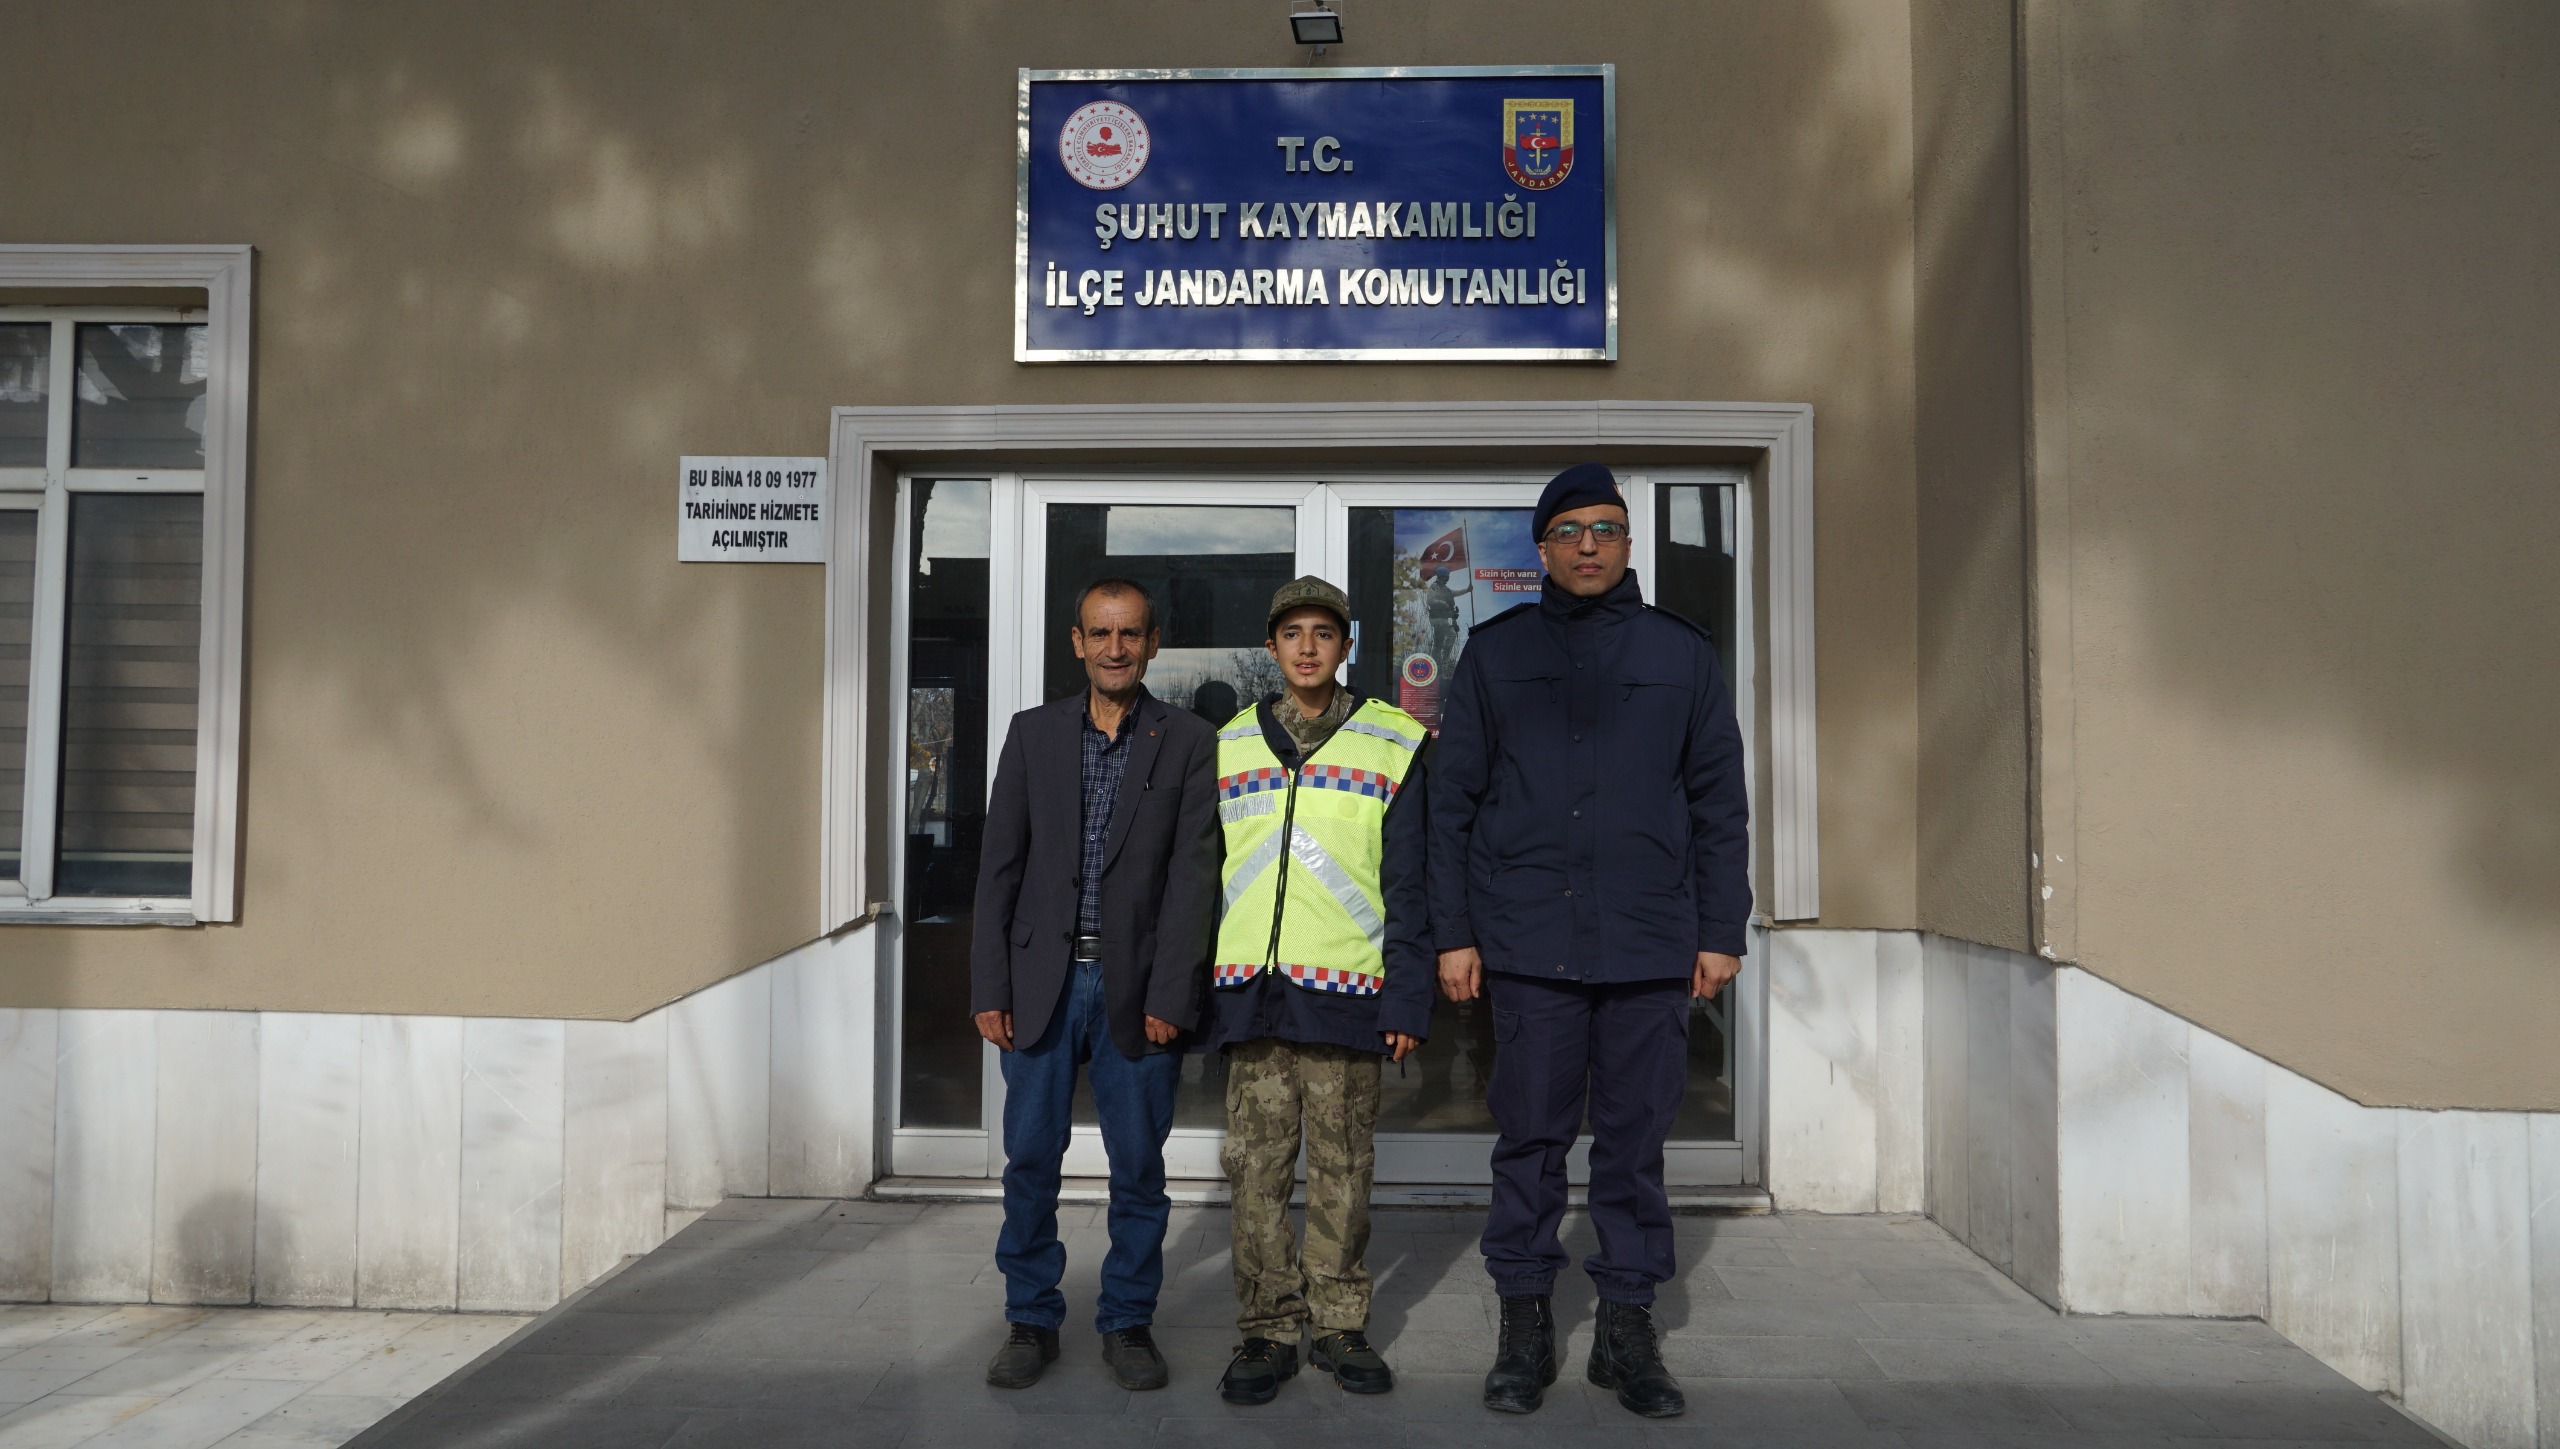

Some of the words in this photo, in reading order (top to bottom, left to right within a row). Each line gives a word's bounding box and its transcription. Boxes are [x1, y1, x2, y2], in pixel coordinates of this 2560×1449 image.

[1278, 136, 1353, 172] T.C.
[1508, 162, 1570, 187] JANDARMA
[1095, 203, 1227, 250] ŞUHUT
[1240, 193, 1536, 238] KAYMAKAMLIĞI
[1046, 261, 1124, 316] İLÇE
[1134, 268, 1329, 306] JANDARMA
[1339, 258, 1586, 306] KOMUTANLIĞI
[689, 469, 707, 487] BU
[711, 466, 743, 488] BİNA
[746, 470, 762, 488] 18
[765, 470, 782, 488] 09
[786, 471, 817, 488] 1977
[685, 499, 756, 520] TARİHİNDE
[760, 499, 819, 521] HİZMETE
[712, 530, 788, 552] AÇILMIŞTIR
[1479, 569, 1499, 578] Sizin
[1500, 569, 1515, 579] için
[1494, 582, 1521, 591] Sizinle
